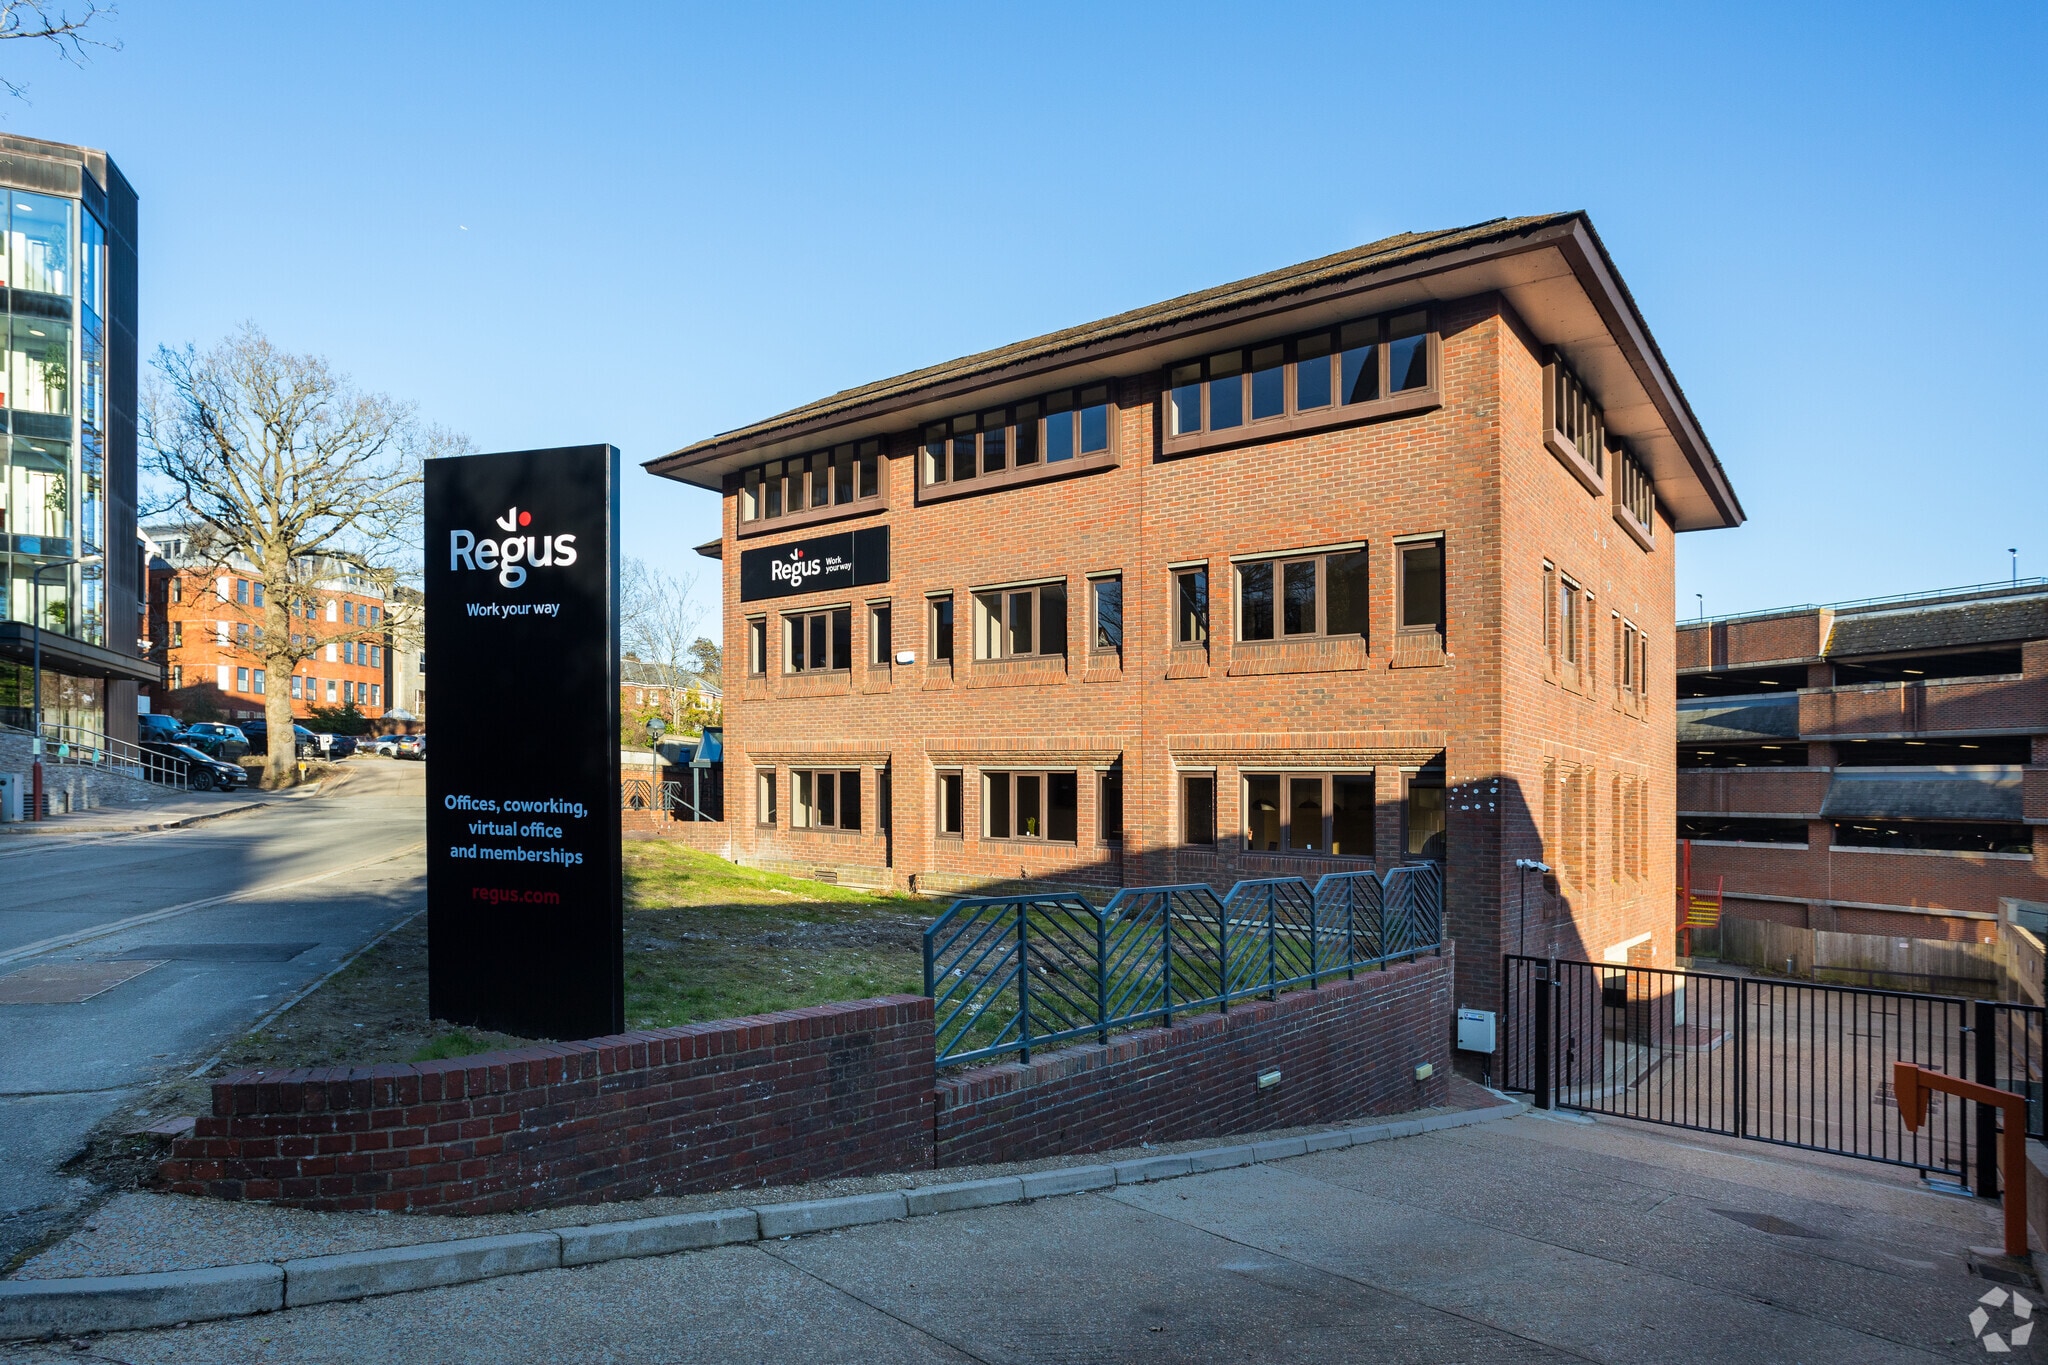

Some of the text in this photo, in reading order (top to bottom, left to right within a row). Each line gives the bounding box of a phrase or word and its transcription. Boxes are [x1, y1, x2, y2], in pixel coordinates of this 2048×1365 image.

[450, 529, 578, 589] Regus
[825, 555, 842, 566] Work
[825, 562, 852, 575] your way
[771, 559, 821, 587] Regus
[466, 601, 561, 620] Work your way
[444, 794, 588, 819] Offices, coworking,
[468, 819, 563, 839] virtual office
[450, 843, 583, 868] and memberships
[472, 885, 561, 905] regus.com
